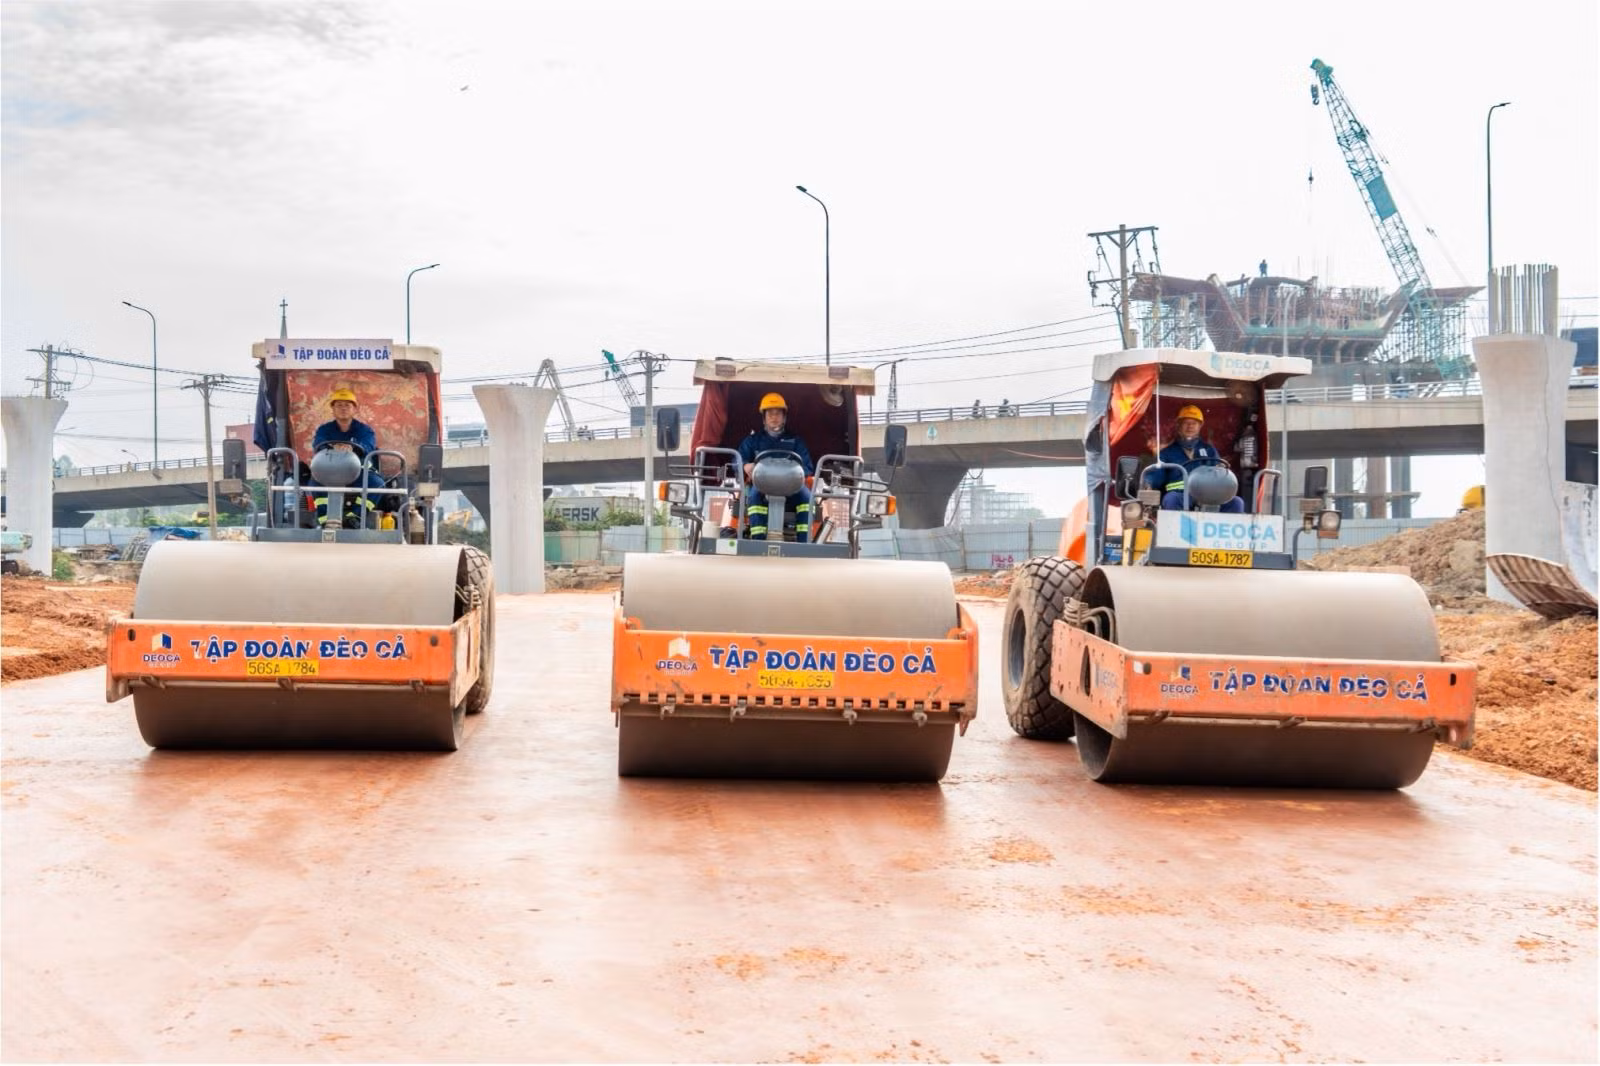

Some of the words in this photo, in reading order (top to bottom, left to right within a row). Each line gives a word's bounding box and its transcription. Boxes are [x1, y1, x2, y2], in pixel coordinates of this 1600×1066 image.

[293, 346, 314, 362] TẬP
[317, 347, 347, 360] ĐOÀN
[350, 347, 372, 360] ĐÈO
[374, 346, 389, 360] CẢ
[1203, 522, 1277, 541] DEOCA
[1191, 552, 1250, 566] 50SA-1787
[319, 636, 368, 659] ĐÈO
[375, 635, 407, 659] CẢ
[143, 654, 181, 662] DEOCA
[658, 660, 698, 671] DEOCA
[708, 644, 759, 674] TẬP
[765, 647, 837, 671] ĐOÀN
[843, 648, 895, 673] ĐÈO
[902, 648, 937, 675] CẢ
[1160, 683, 1199, 694] DEOCA
